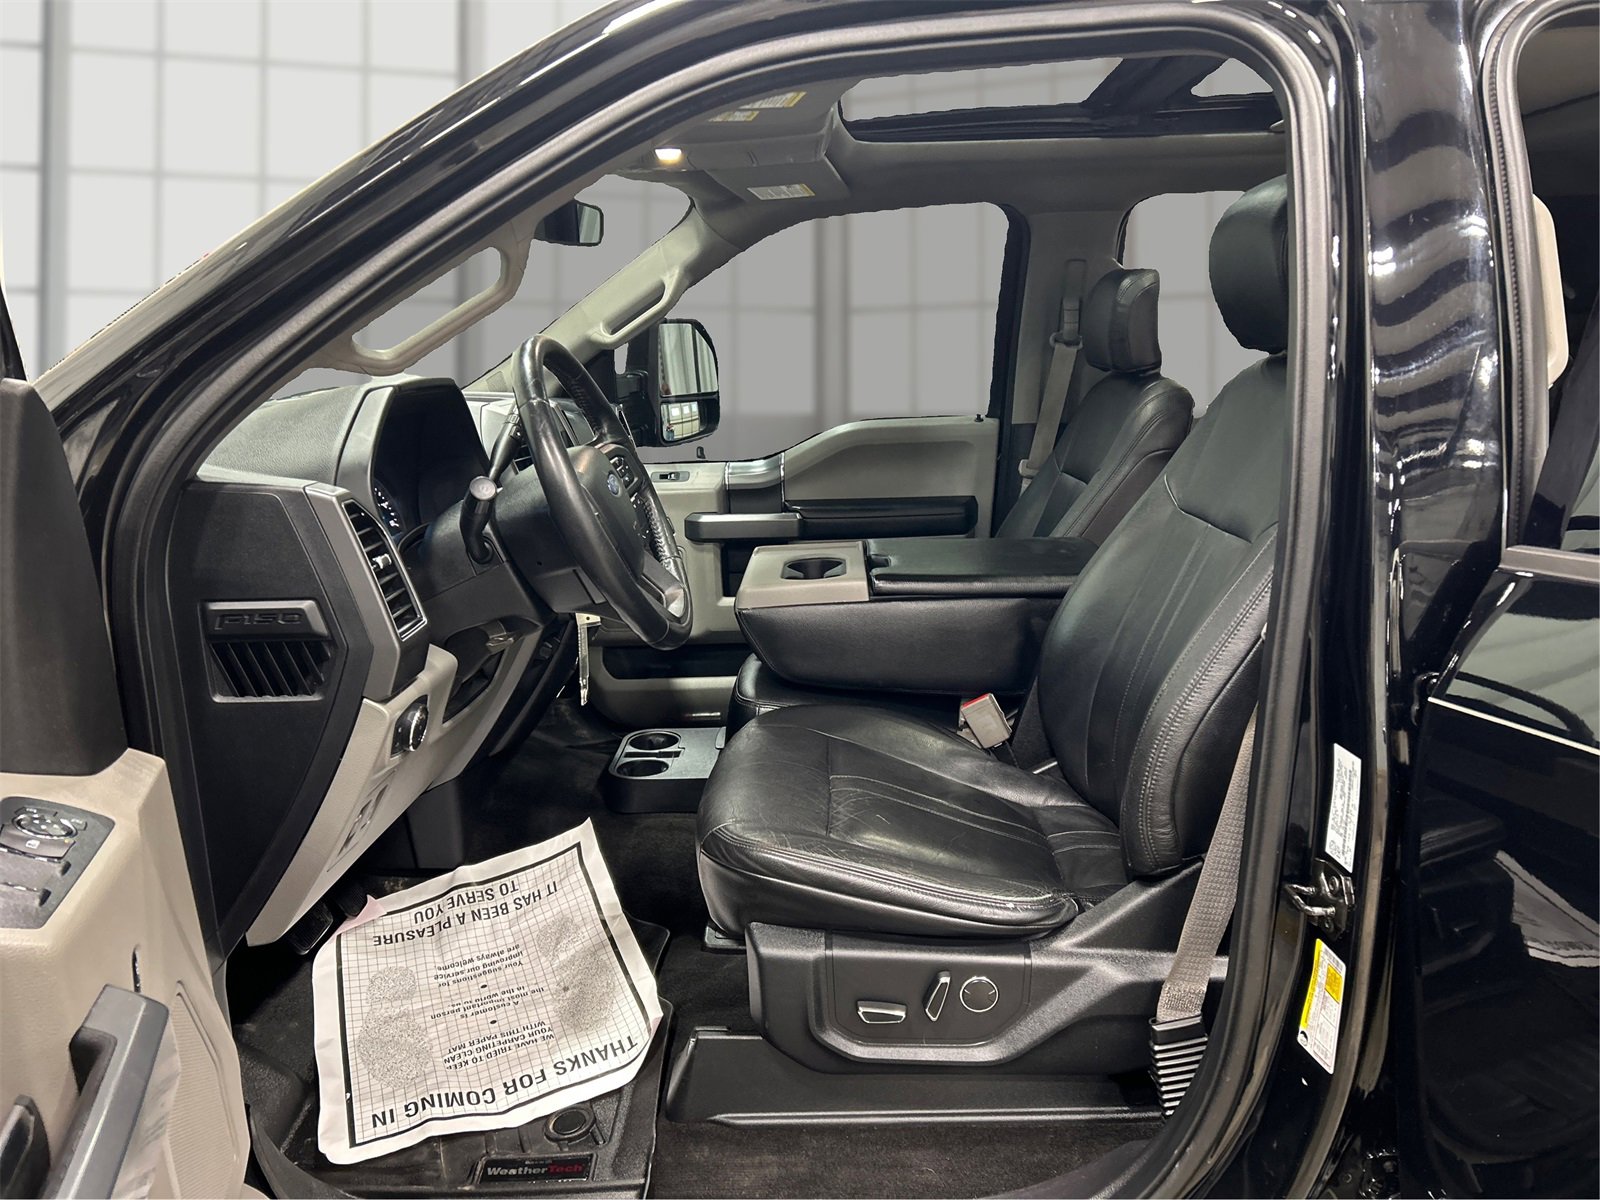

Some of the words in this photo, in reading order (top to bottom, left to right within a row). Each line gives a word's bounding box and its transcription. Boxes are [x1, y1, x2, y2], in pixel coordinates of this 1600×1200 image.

[499, 880, 519, 896] TO
[546, 880, 558, 897] IT
[447, 887, 495, 910] SERVE
[514, 889, 542, 911] HAS
[413, 905, 444, 924] YOU
[455, 912, 466, 926] A
[471, 902, 510, 922] BEEN
[373, 916, 451, 947] PLEASURE
[476, 949, 505, 961] always
[506, 944, 520, 952] are
[482, 951, 524, 969] improving
[504, 960, 524, 969] Your
[433, 970, 465, 980] service
[452, 965, 503, 984] suggestions
[501, 988, 515, 996] the
[508, 992, 529, 1000] most
[463, 996, 506, 1012] important
[470, 1001, 511, 1017] customer
[430, 1007, 461, 1020] person
[500, 1027, 521, 1037] THIS
[522, 1020, 546, 1031] WITH
[527, 1026, 553, 1037] YOUR
[468, 1034, 498, 1046] PAPER
[475, 1034, 526, 1055] CARPETING
[516, 1038, 538, 1048] HAVE
[447, 1044, 466, 1054] MAT
[486, 1046, 512, 1059] TRIED
[553, 1035, 638, 1076] THANKS
[443, 1049, 473, 1064] CLEAN
[471, 1055, 484, 1064] TO
[502, 1068, 547, 1096] FOR
[403, 1088, 496, 1118] COMING
[372, 1108, 396, 1129] IN
[487, 1164, 583, 1176] WeatherTech
